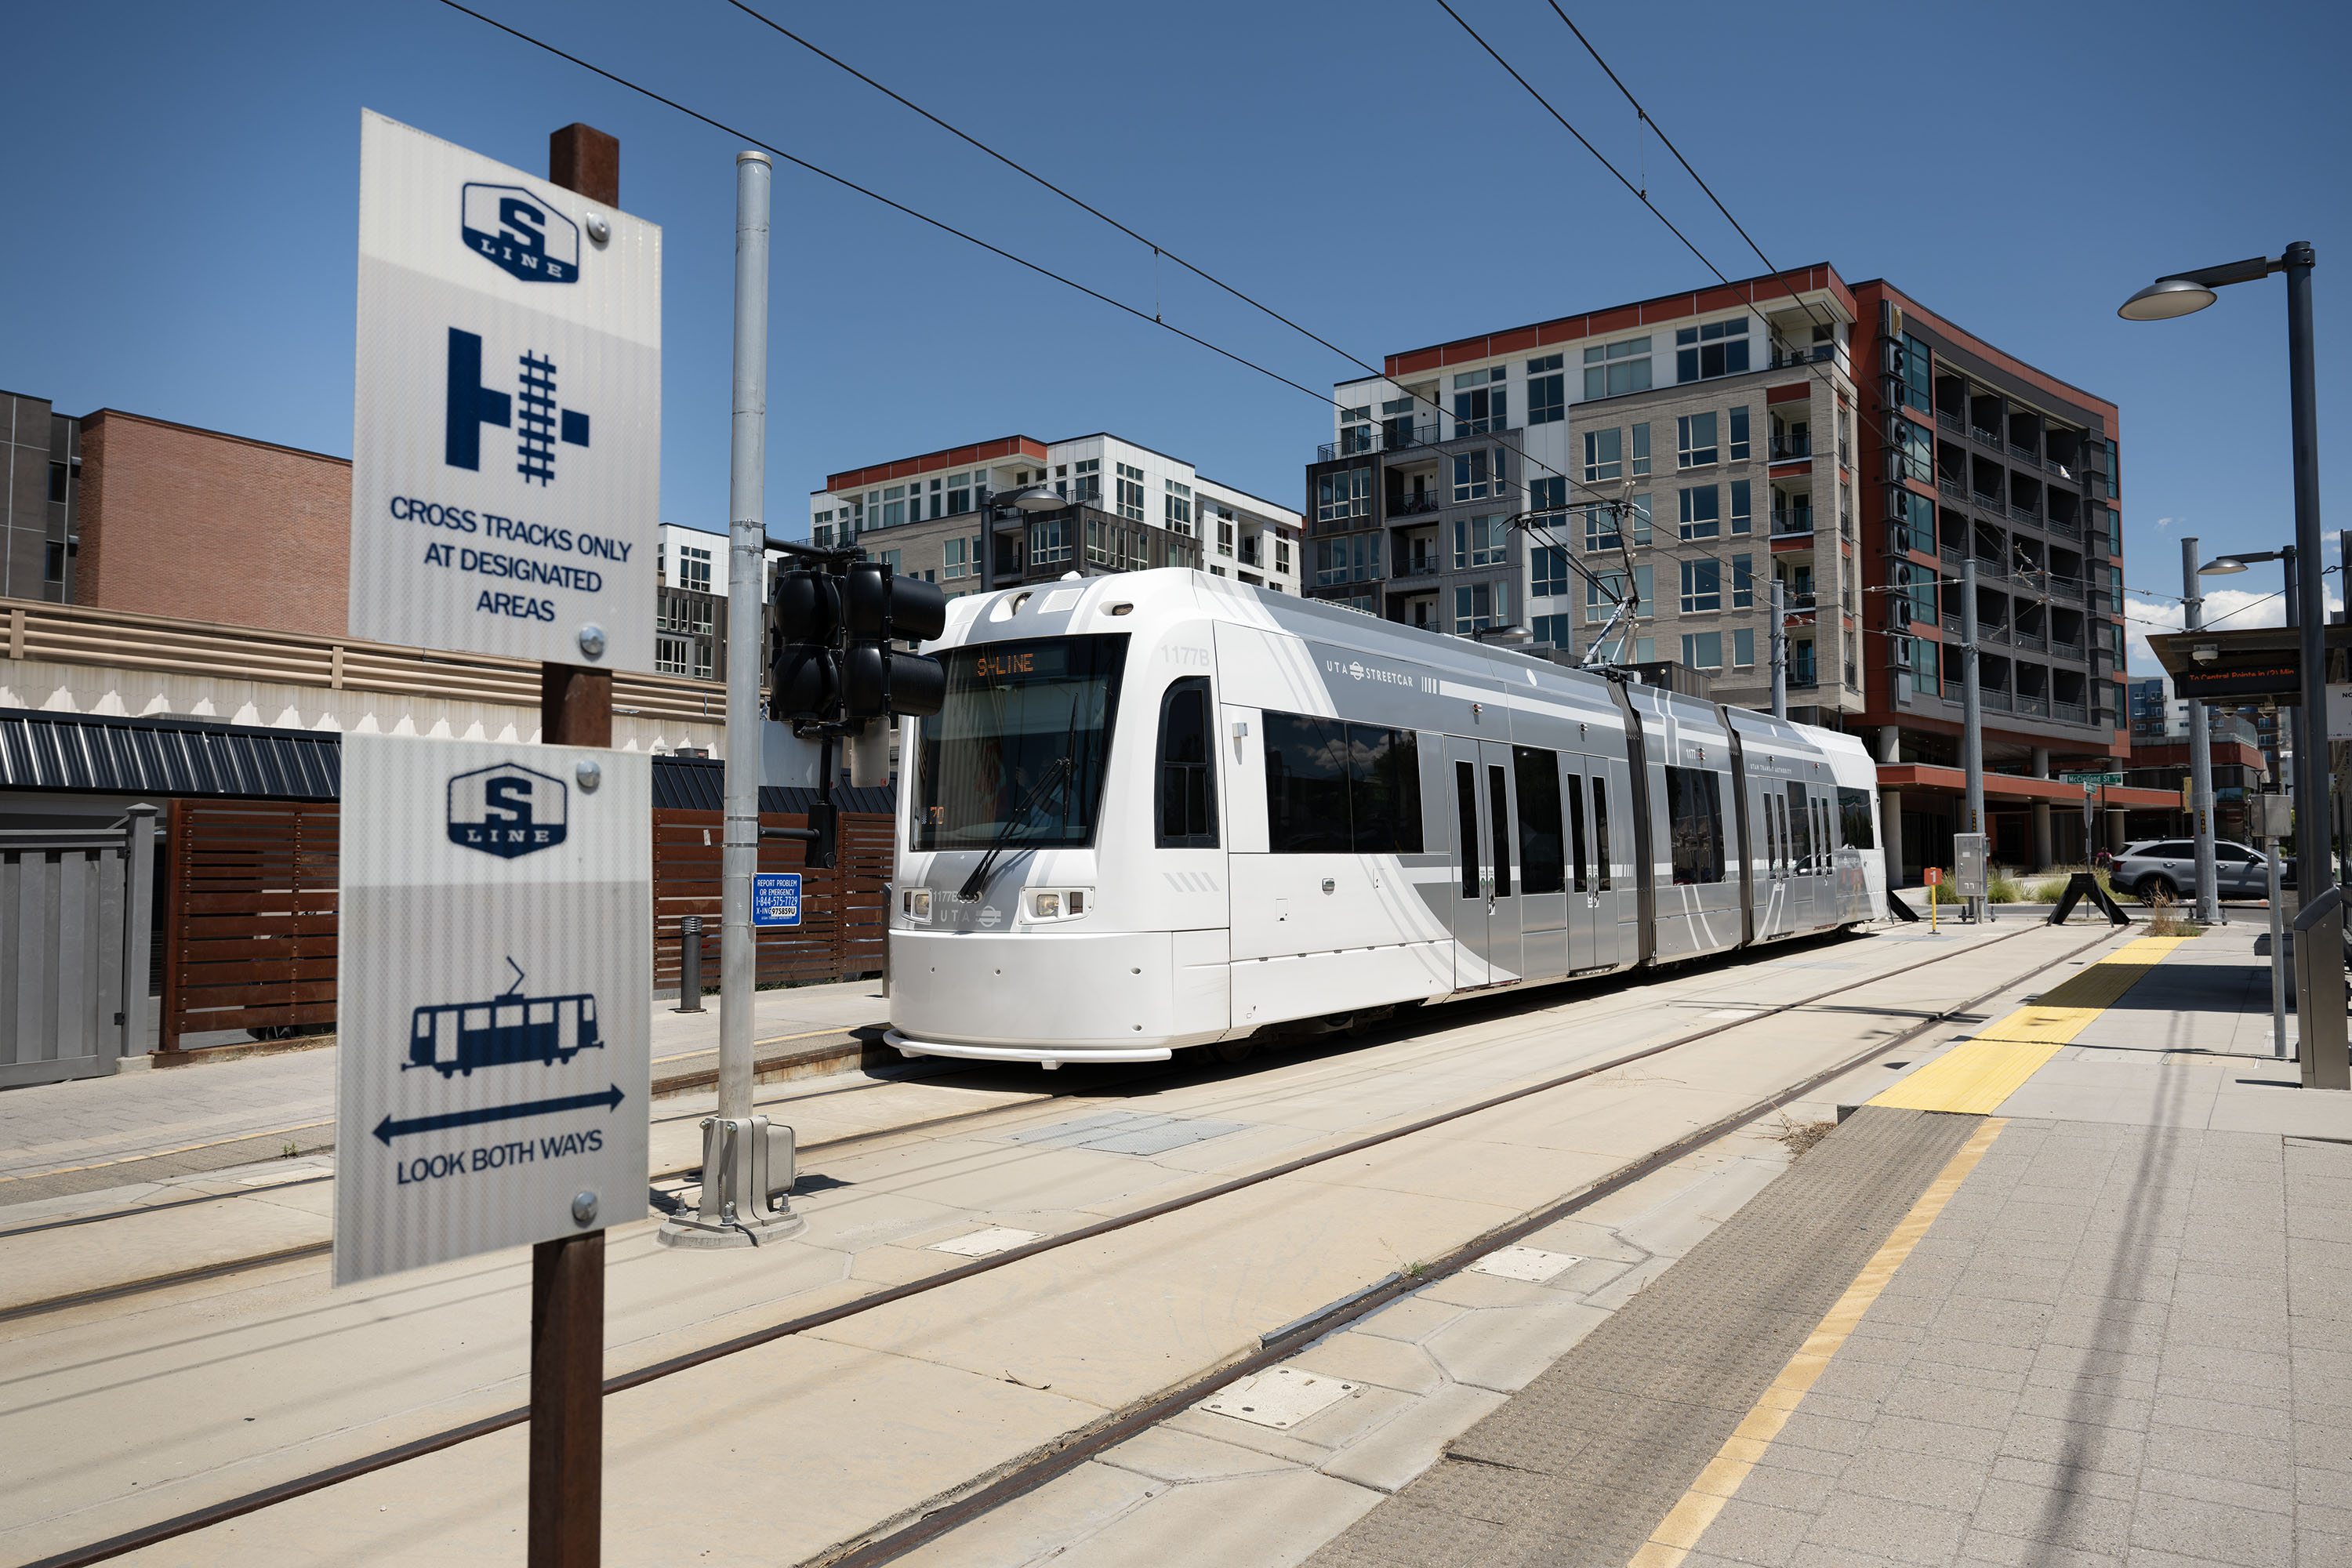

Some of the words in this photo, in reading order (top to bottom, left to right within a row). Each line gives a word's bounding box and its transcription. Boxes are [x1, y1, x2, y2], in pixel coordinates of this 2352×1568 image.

[499, 198, 545, 256] S
[481, 238, 562, 278] LINE
[390, 496, 477, 533] CROSS
[482, 514, 573, 551] TRACKS
[577, 534, 632, 563] ONLY
[424, 543, 456, 568] AT
[460, 548, 602, 593] DESIGNATED
[476, 590, 556, 622] AREAS
[977, 653, 1034, 677] S-LINE
[1160, 644, 1210, 666] 1177B
[1327, 660, 1348, 674] UTA
[1366, 668, 1414, 687] STREETCAR
[485, 777, 532, 825] S
[467, 829, 550, 843] LINE
[1929, 870, 1936, 883] 1
[756, 897, 798, 906] 1-844-575-7729
[934, 891, 958, 902] 1177B
[941, 910, 970, 922] UTA
[397, 1151, 466, 1185] LOOK
[472, 1140, 534, 1171] BOTH
[540, 1130, 603, 1159] WAYS
